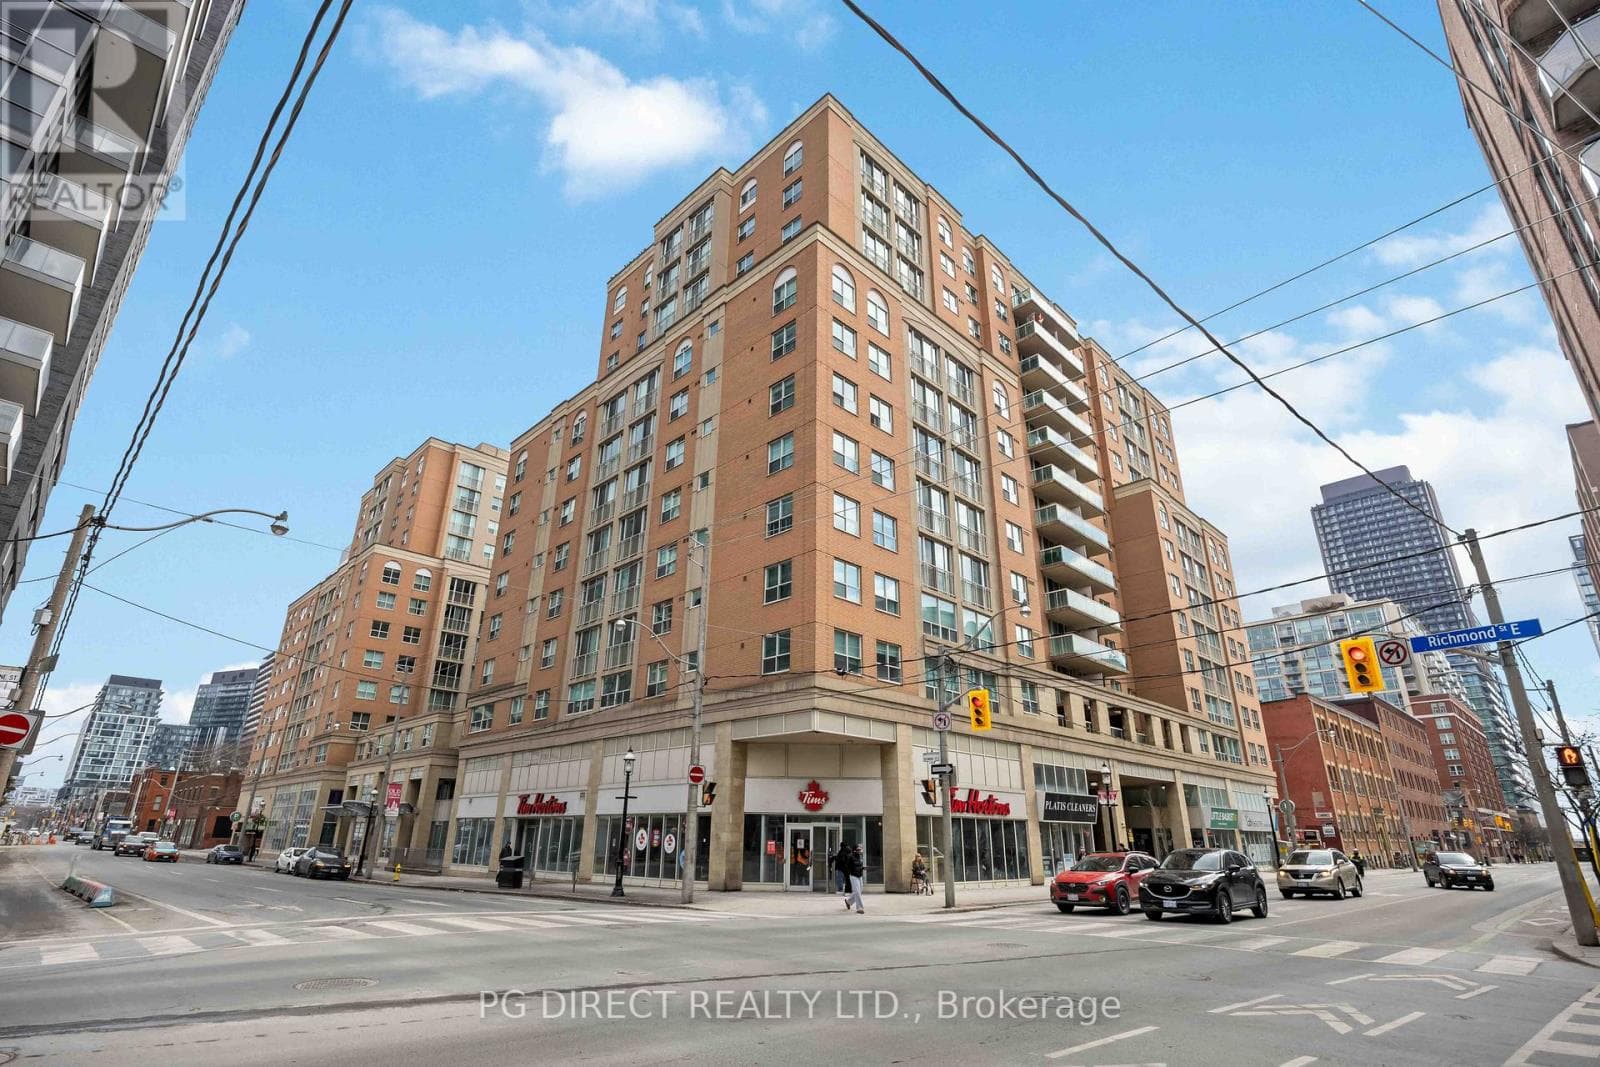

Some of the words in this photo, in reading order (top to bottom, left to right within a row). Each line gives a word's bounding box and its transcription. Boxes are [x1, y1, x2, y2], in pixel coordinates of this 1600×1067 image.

[1427, 626, 1497, 647] Richmond
[1499, 624, 1508, 632] St
[1510, 623, 1521, 636] E
[803, 791, 826, 804] Tims
[966, 788, 1010, 816] Hortons
[1045, 800, 1066, 811] PLATIS
[1066, 802, 1096, 813] CLEANERS
